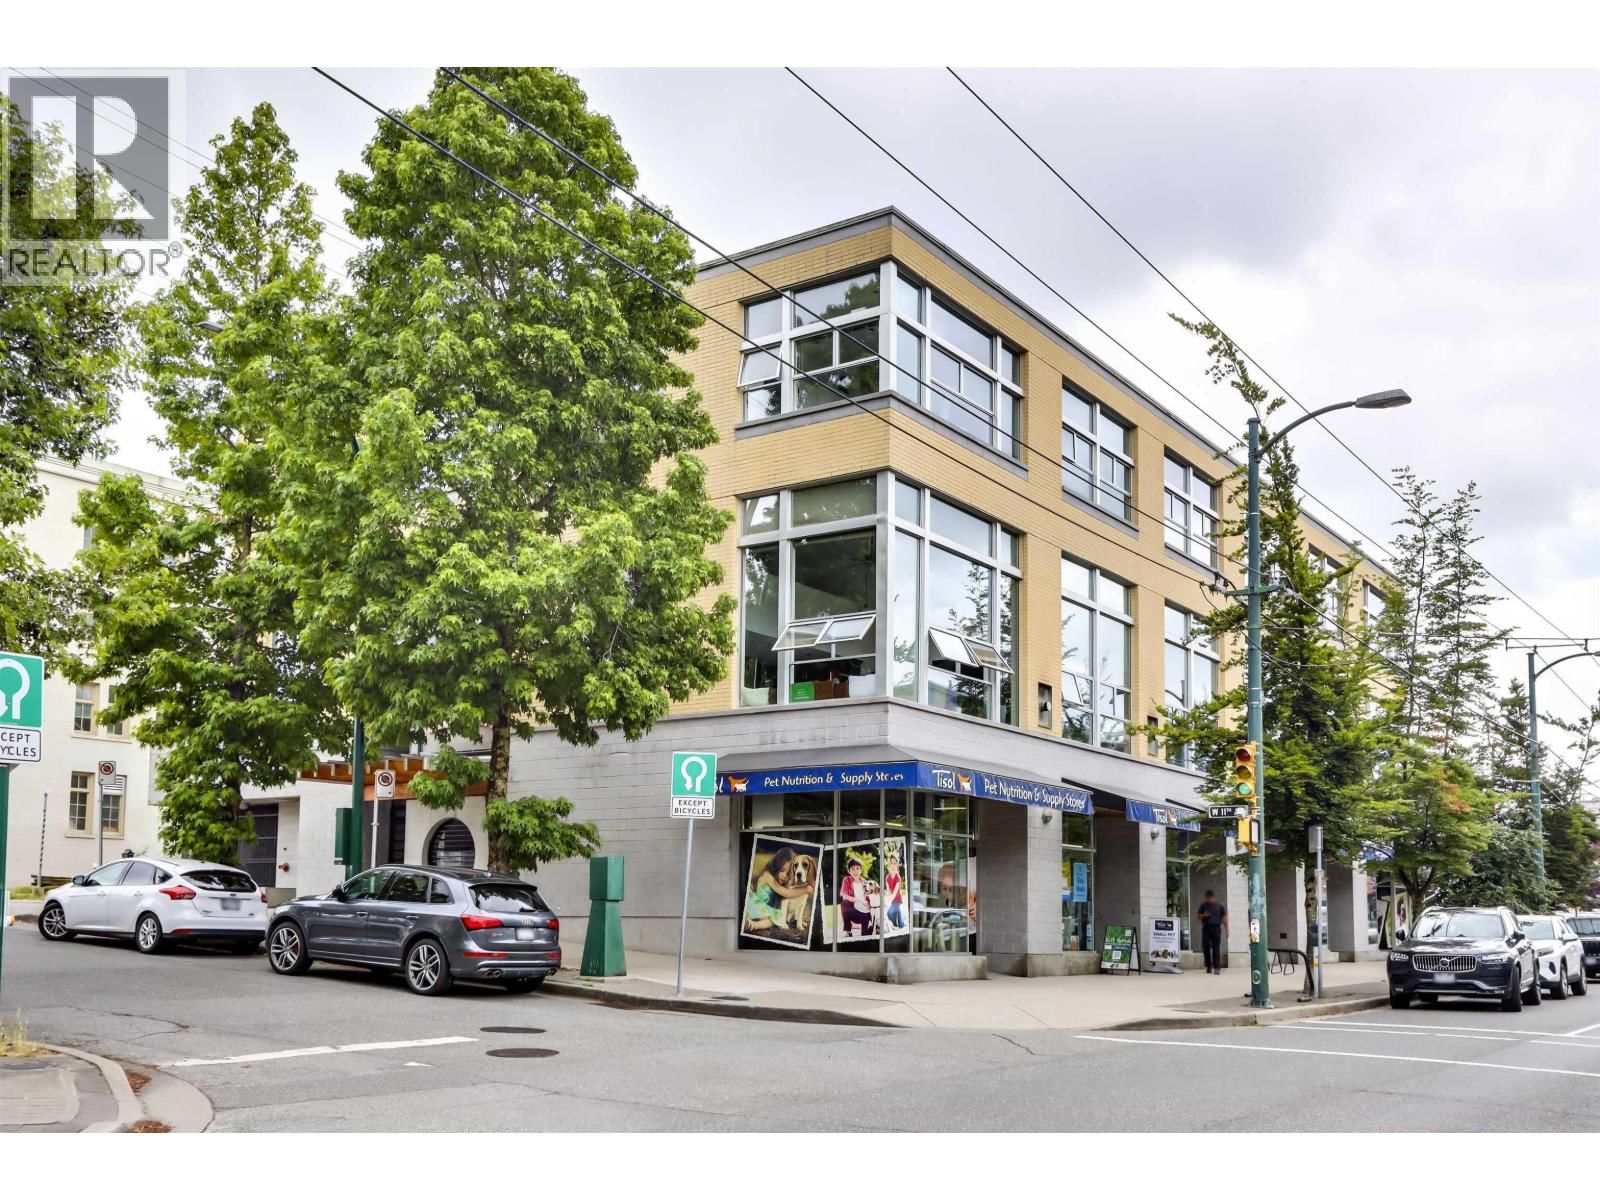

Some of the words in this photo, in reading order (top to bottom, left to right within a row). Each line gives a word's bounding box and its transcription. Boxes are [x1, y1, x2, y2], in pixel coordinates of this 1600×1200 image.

[0, 732, 31, 743] CEPT
[0, 745, 37, 757] YCLES
[764, 777, 779, 787] Pet
[781, 774, 823, 786] Nutrition
[826, 772, 834, 784] &
[840, 771, 873, 786] Supply
[931, 769, 956, 790] Tisol
[984, 777, 998, 795] Pet
[1000, 781, 1033, 801] Nutrition
[1034, 787, 1040, 802] &
[1042, 788, 1065, 809] Supply
[1065, 792, 1085, 809] Stores
[678, 799, 707, 807] EXCEPT
[674, 807, 711, 815] BICYCLES
[1211, 808, 1219, 816] W
